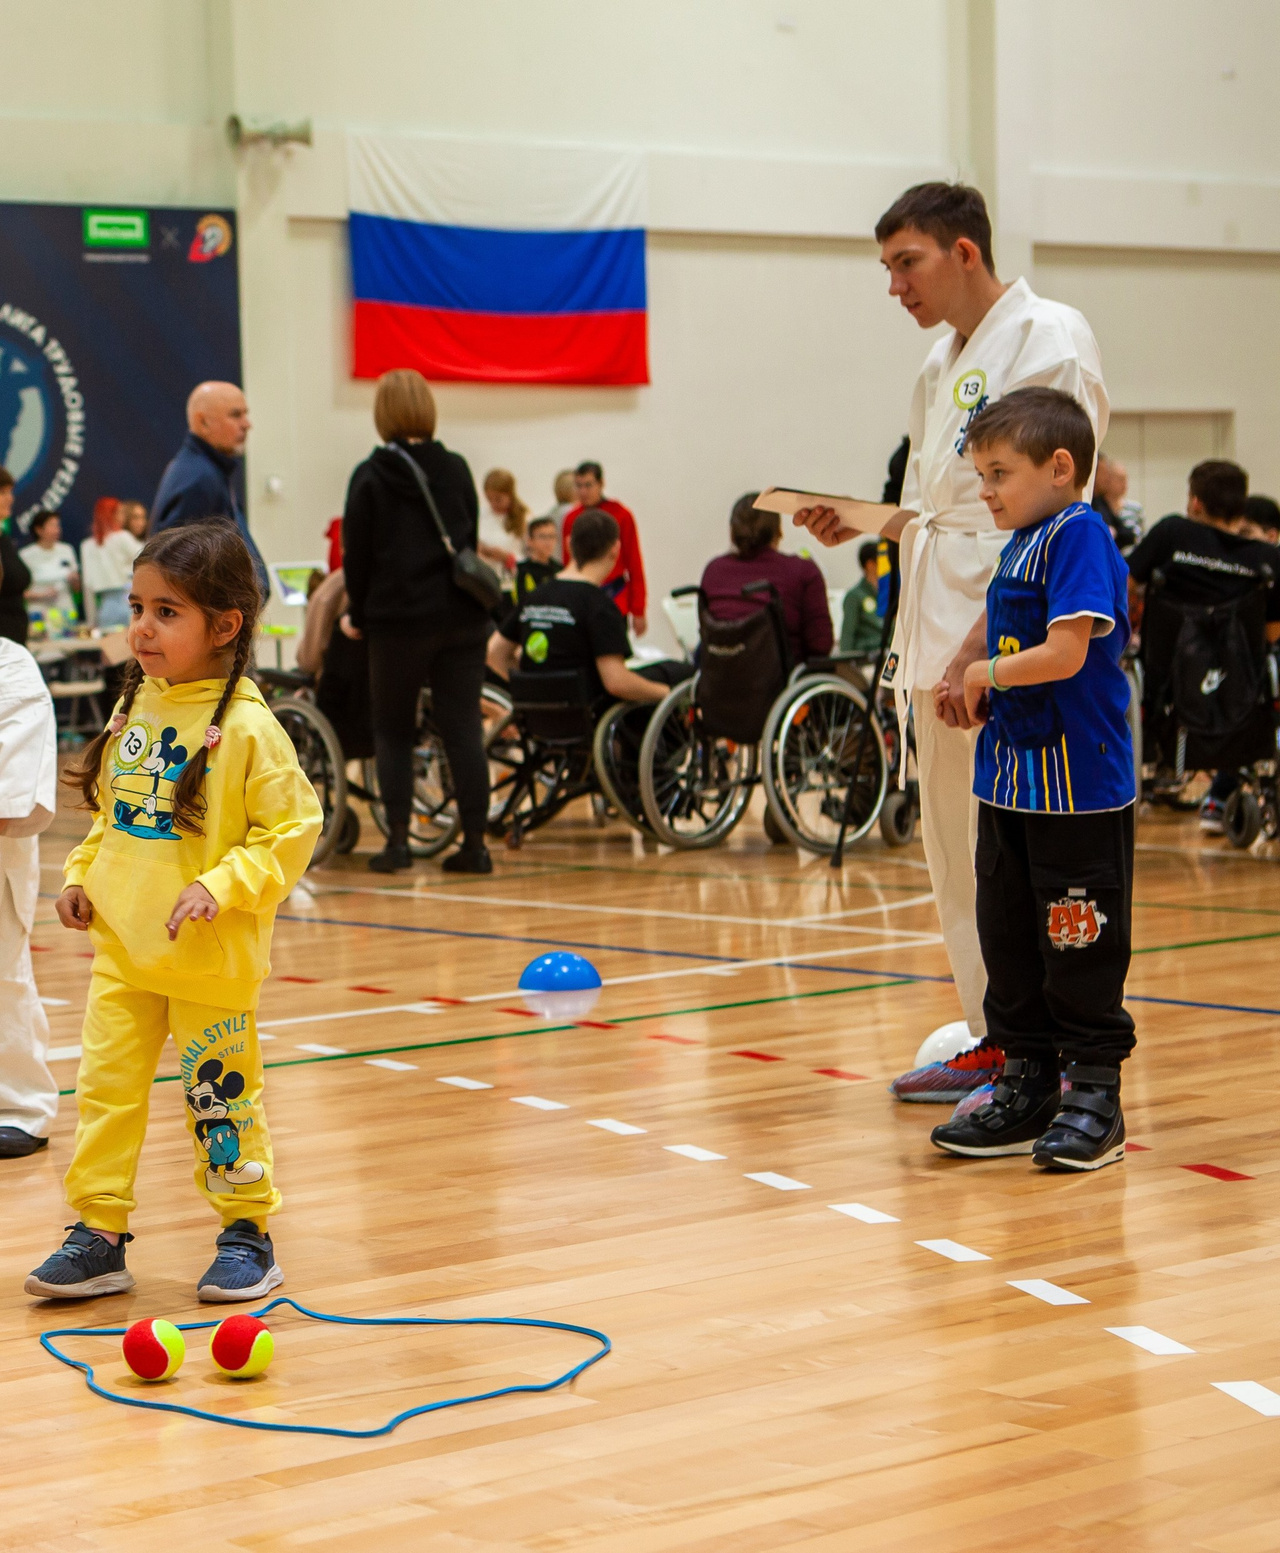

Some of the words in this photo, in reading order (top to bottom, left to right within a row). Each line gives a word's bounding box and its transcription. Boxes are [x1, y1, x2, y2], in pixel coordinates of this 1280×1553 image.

[963, 382, 980, 396] 13
[124, 731, 142, 756] 13
[203, 1013, 247, 1044] STYLE
[217, 1041, 245, 1059] STYLE
